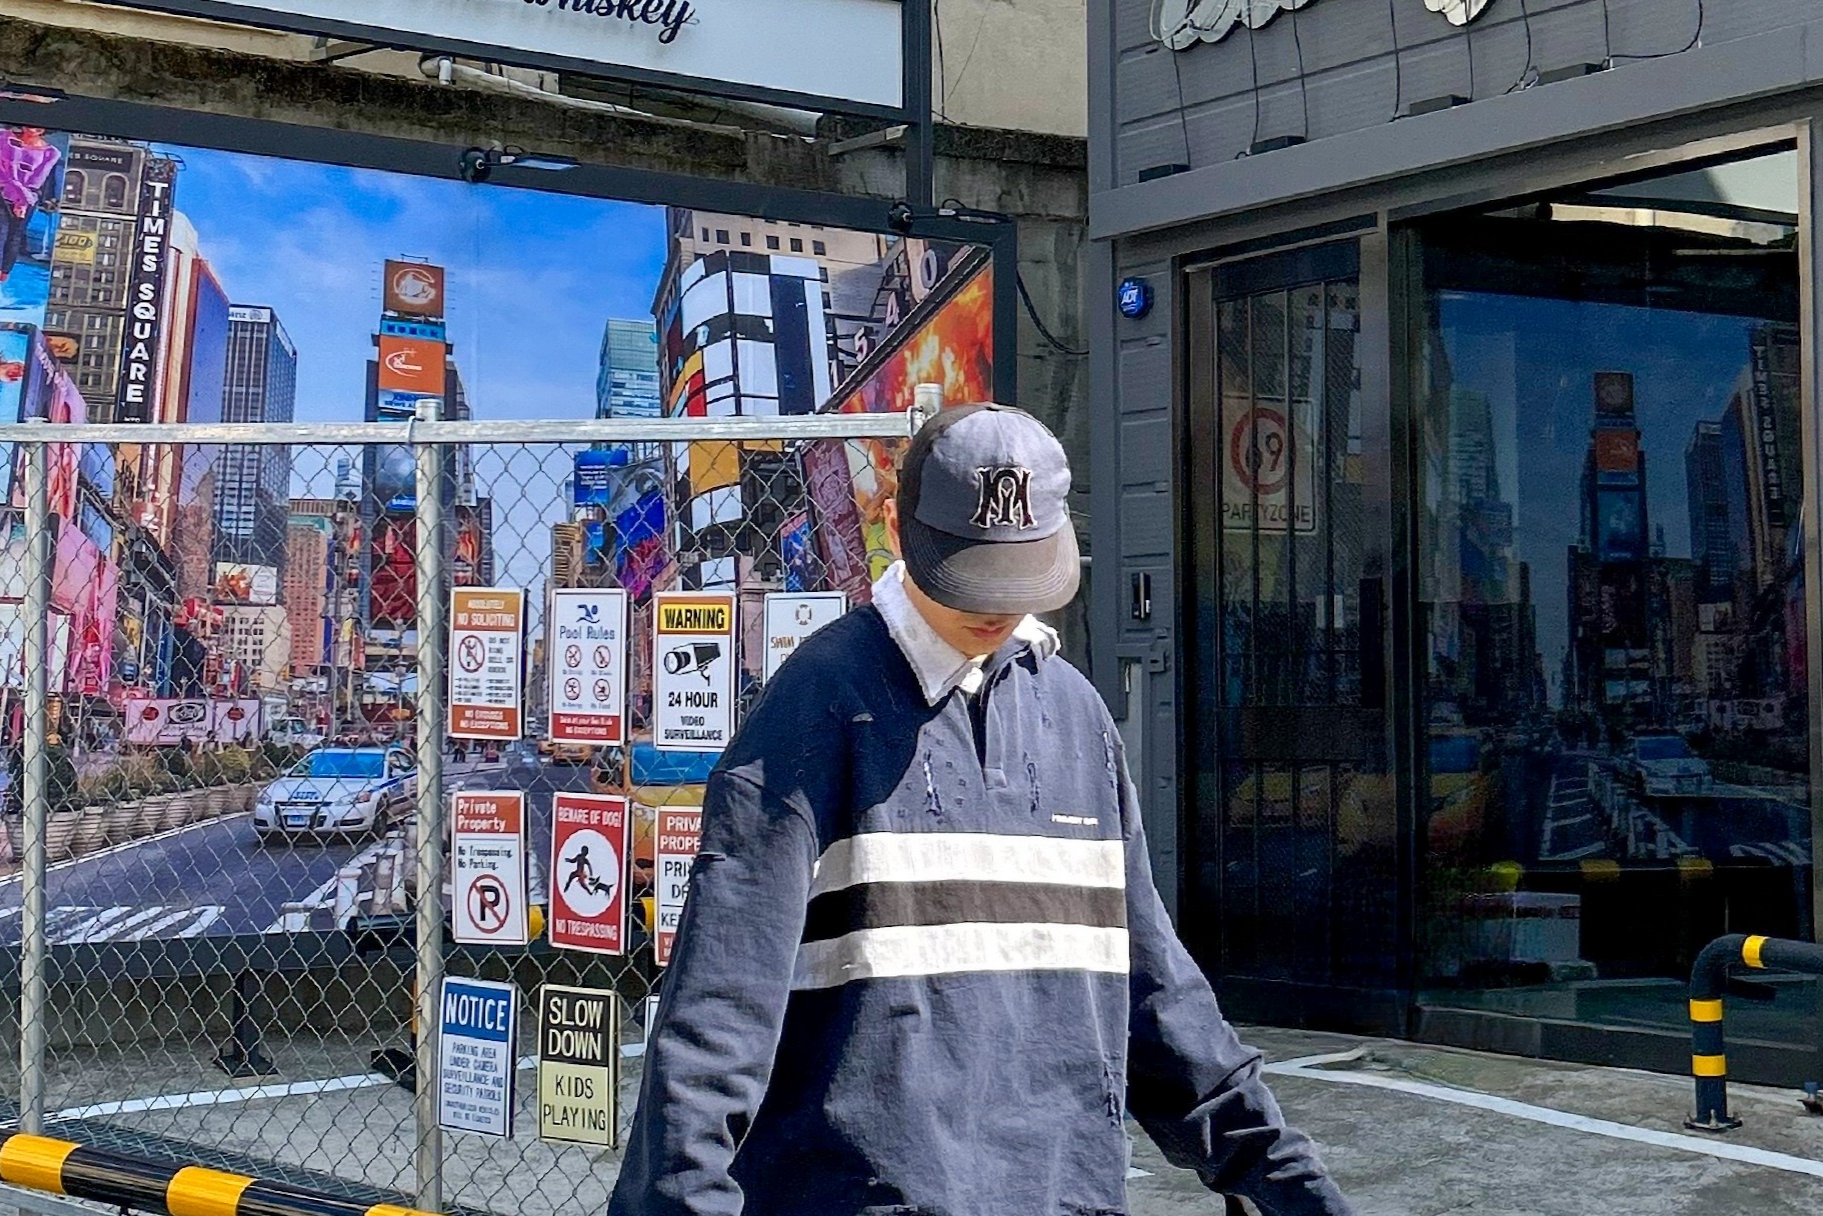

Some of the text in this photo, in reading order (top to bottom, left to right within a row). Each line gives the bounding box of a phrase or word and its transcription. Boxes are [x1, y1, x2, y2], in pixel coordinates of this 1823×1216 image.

[126, 182, 169, 403] TIMES SQUARE
[457, 613, 515, 627] NO SOLICITING
[664, 608, 725, 630] WARNING
[560, 626, 616, 640] Pool Rules
[668, 691, 718, 708] 24 HOUR
[680, 715, 705, 726] VIDEO
[664, 728, 723, 741] SURVEILLANCE
[458, 798, 497, 814] Private
[458, 815, 506, 832] Property
[558, 806, 622, 827] BEWARE OF DOG!
[556, 919, 618, 941] NO TRESPASSING
[445, 992, 507, 1031] NOTICE
[549, 997, 603, 1029] SLOW
[452, 1042, 496, 1059] PARKING AREA
[548, 1029, 602, 1061] DOWN
[449, 1056, 470, 1068] UNDER
[444, 1083, 473, 1098] SECURITY
[555, 1074, 594, 1099] KIDS
[543, 1103, 606, 1131] PLAYING
